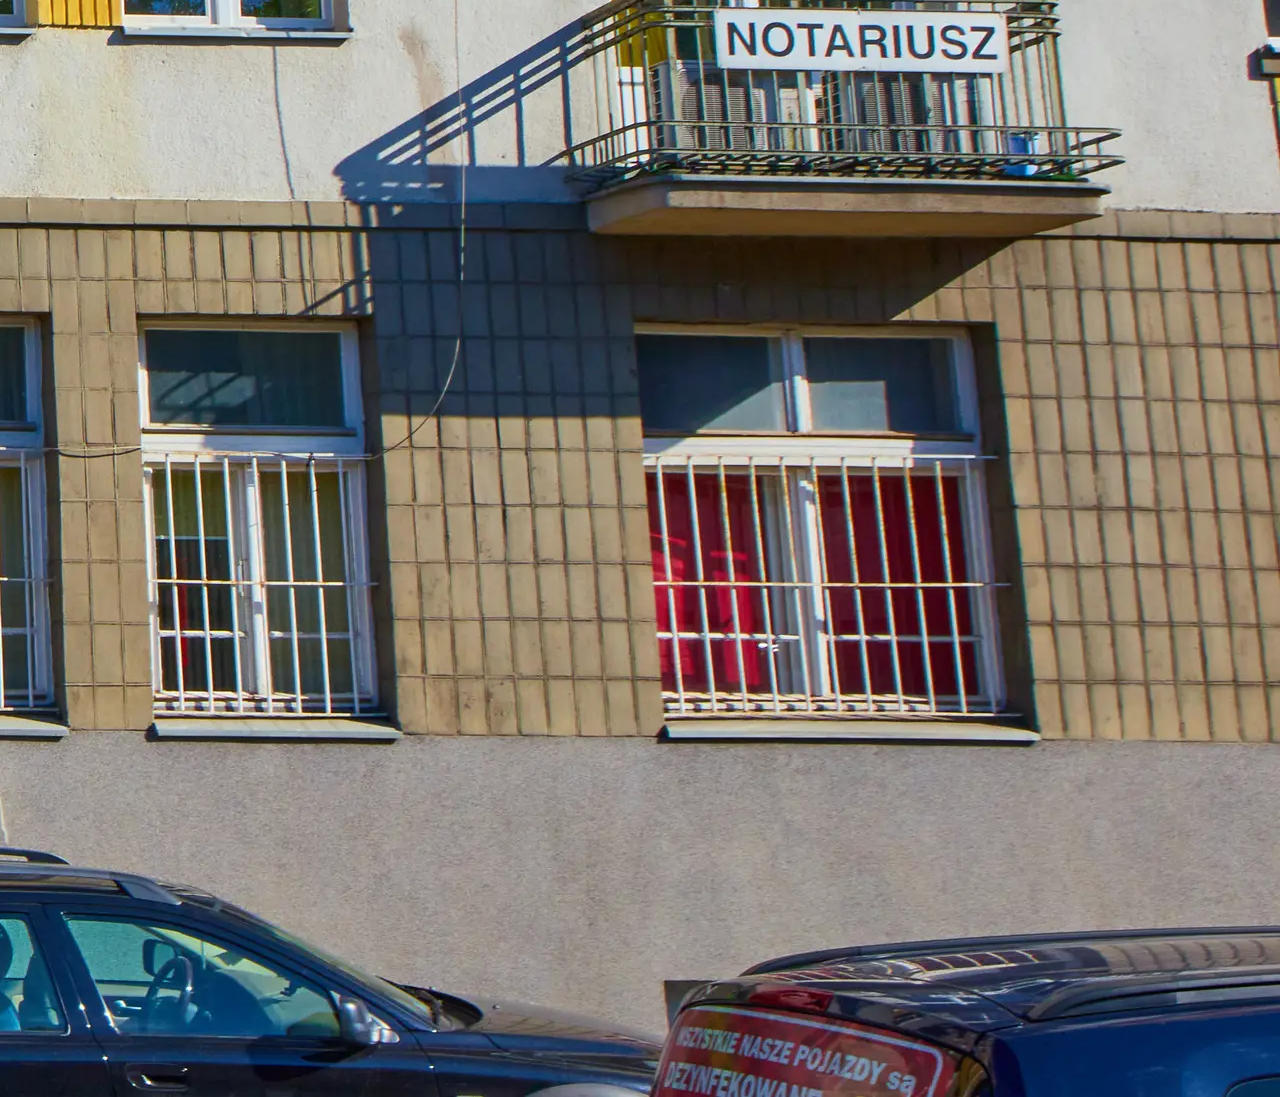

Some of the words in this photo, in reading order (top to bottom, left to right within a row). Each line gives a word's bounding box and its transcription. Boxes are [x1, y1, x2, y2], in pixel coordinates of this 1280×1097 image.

[727, 21, 998, 61] NOTARIUSZ
[737, 1034, 796, 1065] NASZE
[793, 1045, 888, 1085] POJAZDY
[886, 1071, 917, 1096] są
